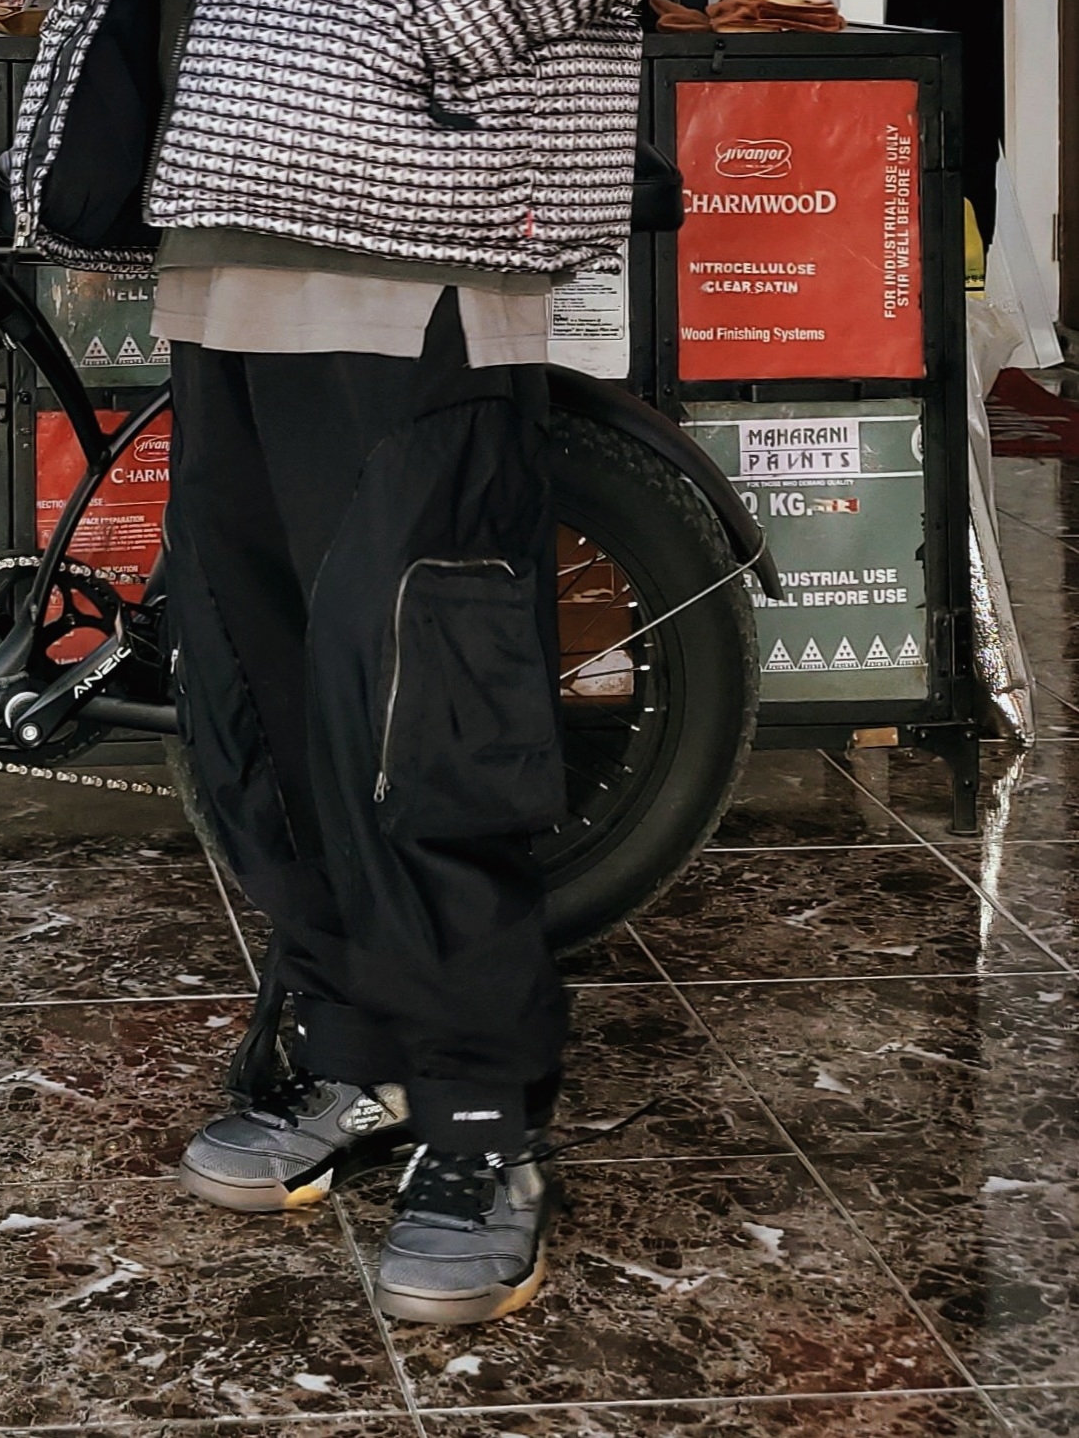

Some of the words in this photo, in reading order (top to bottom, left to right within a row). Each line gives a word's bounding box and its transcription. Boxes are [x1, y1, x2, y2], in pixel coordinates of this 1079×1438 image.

[886, 124, 899, 163] ONLY
[899, 135, 911, 168] USE
[885, 165, 898, 197] USE
[897, 169, 911, 225] BEFORE
[884, 198, 897, 287] INDUSTRIAL
[897, 228, 910, 272] WELL
[689, 261, 817, 276] NITROCELLULOSE
[702, 280, 751, 294] CLEAR
[754, 281, 799, 294] SATIN
[897, 275, 910, 307] STIR
[884, 289, 897, 319] FOR
[681, 327, 714, 341] Wood
[716, 327, 771, 343] Finishing
[773, 327, 826, 343] Systems
[748, 426, 849, 447] MAHARANI
[769, 492, 814, 517] KG.
[758, 571, 859, 588] DUSTRIAL
[863, 568, 898, 585] USE
[802, 590, 870, 607] BEFORE
[873, 588, 908, 604] USE
